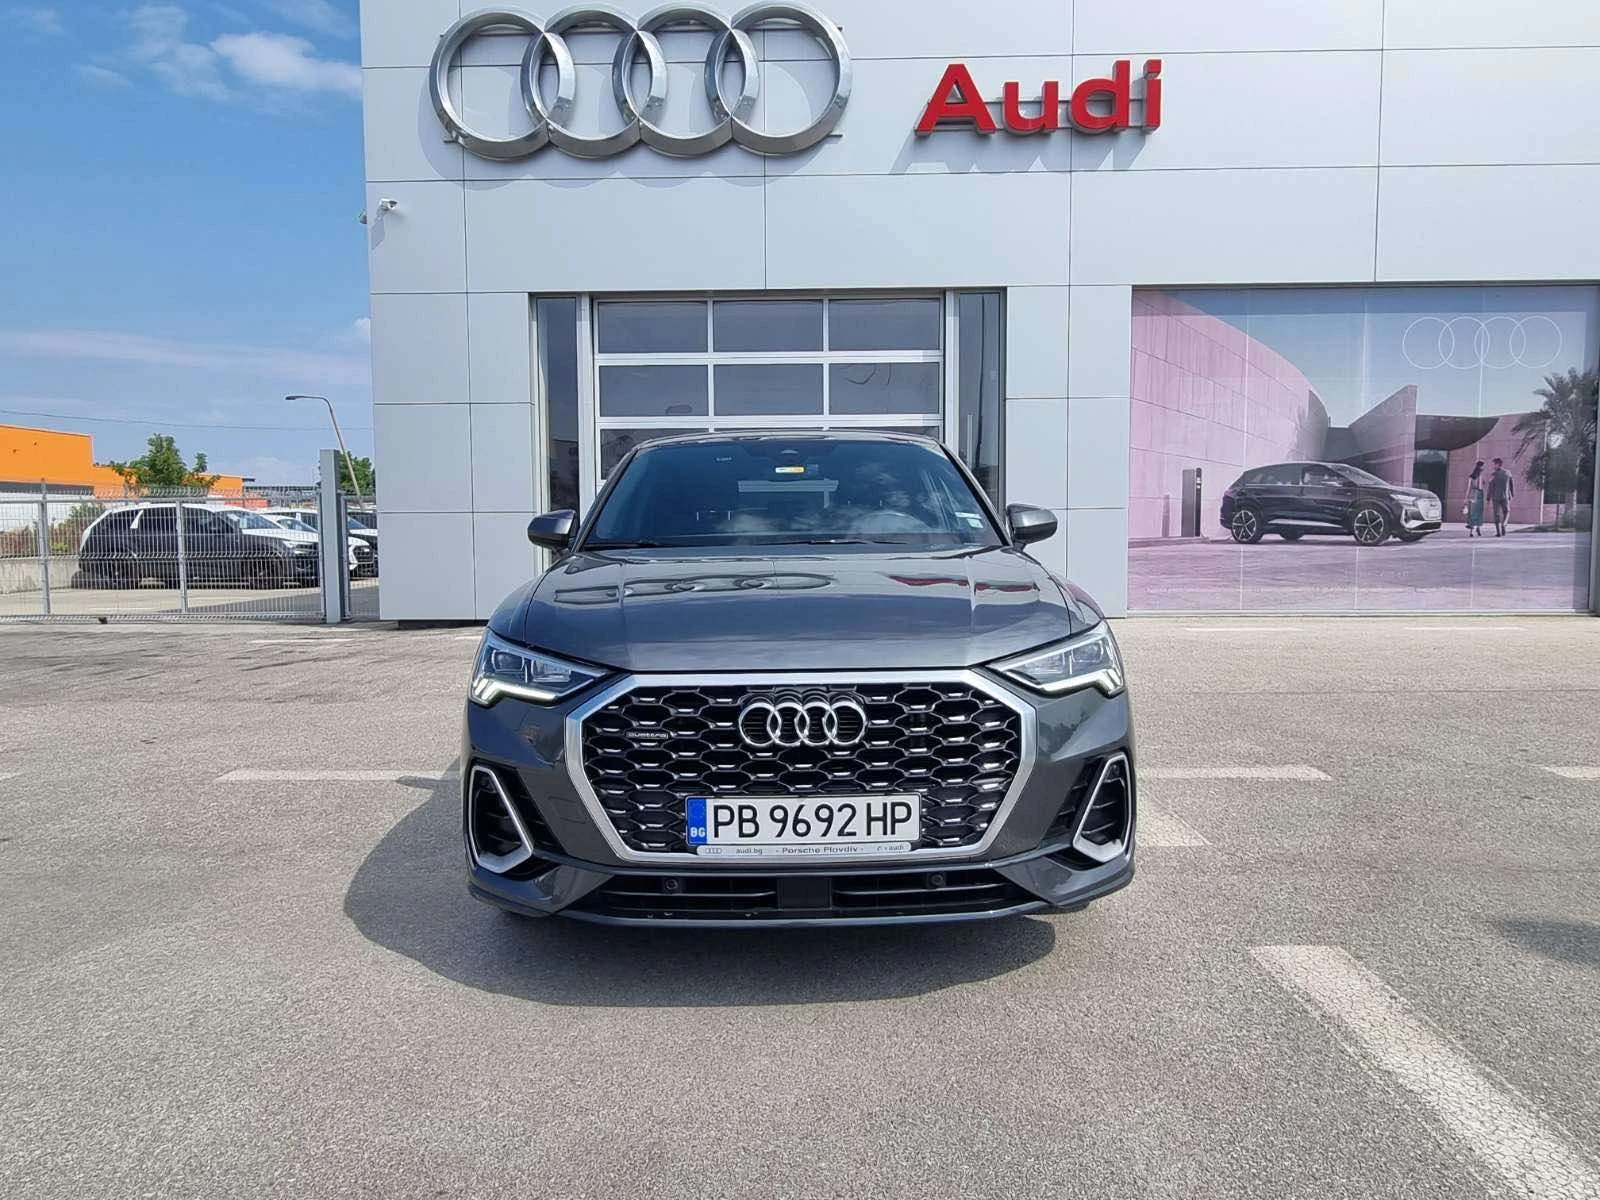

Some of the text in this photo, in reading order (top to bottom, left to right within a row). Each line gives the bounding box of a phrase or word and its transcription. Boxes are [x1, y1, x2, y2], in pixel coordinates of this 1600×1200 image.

[915, 59, 1162, 135] Audi
[713, 801, 912, 838] PB 9692 HP
[690, 827, 706, 838] BG
[782, 845, 858, 854] Porsche Plovdiv
